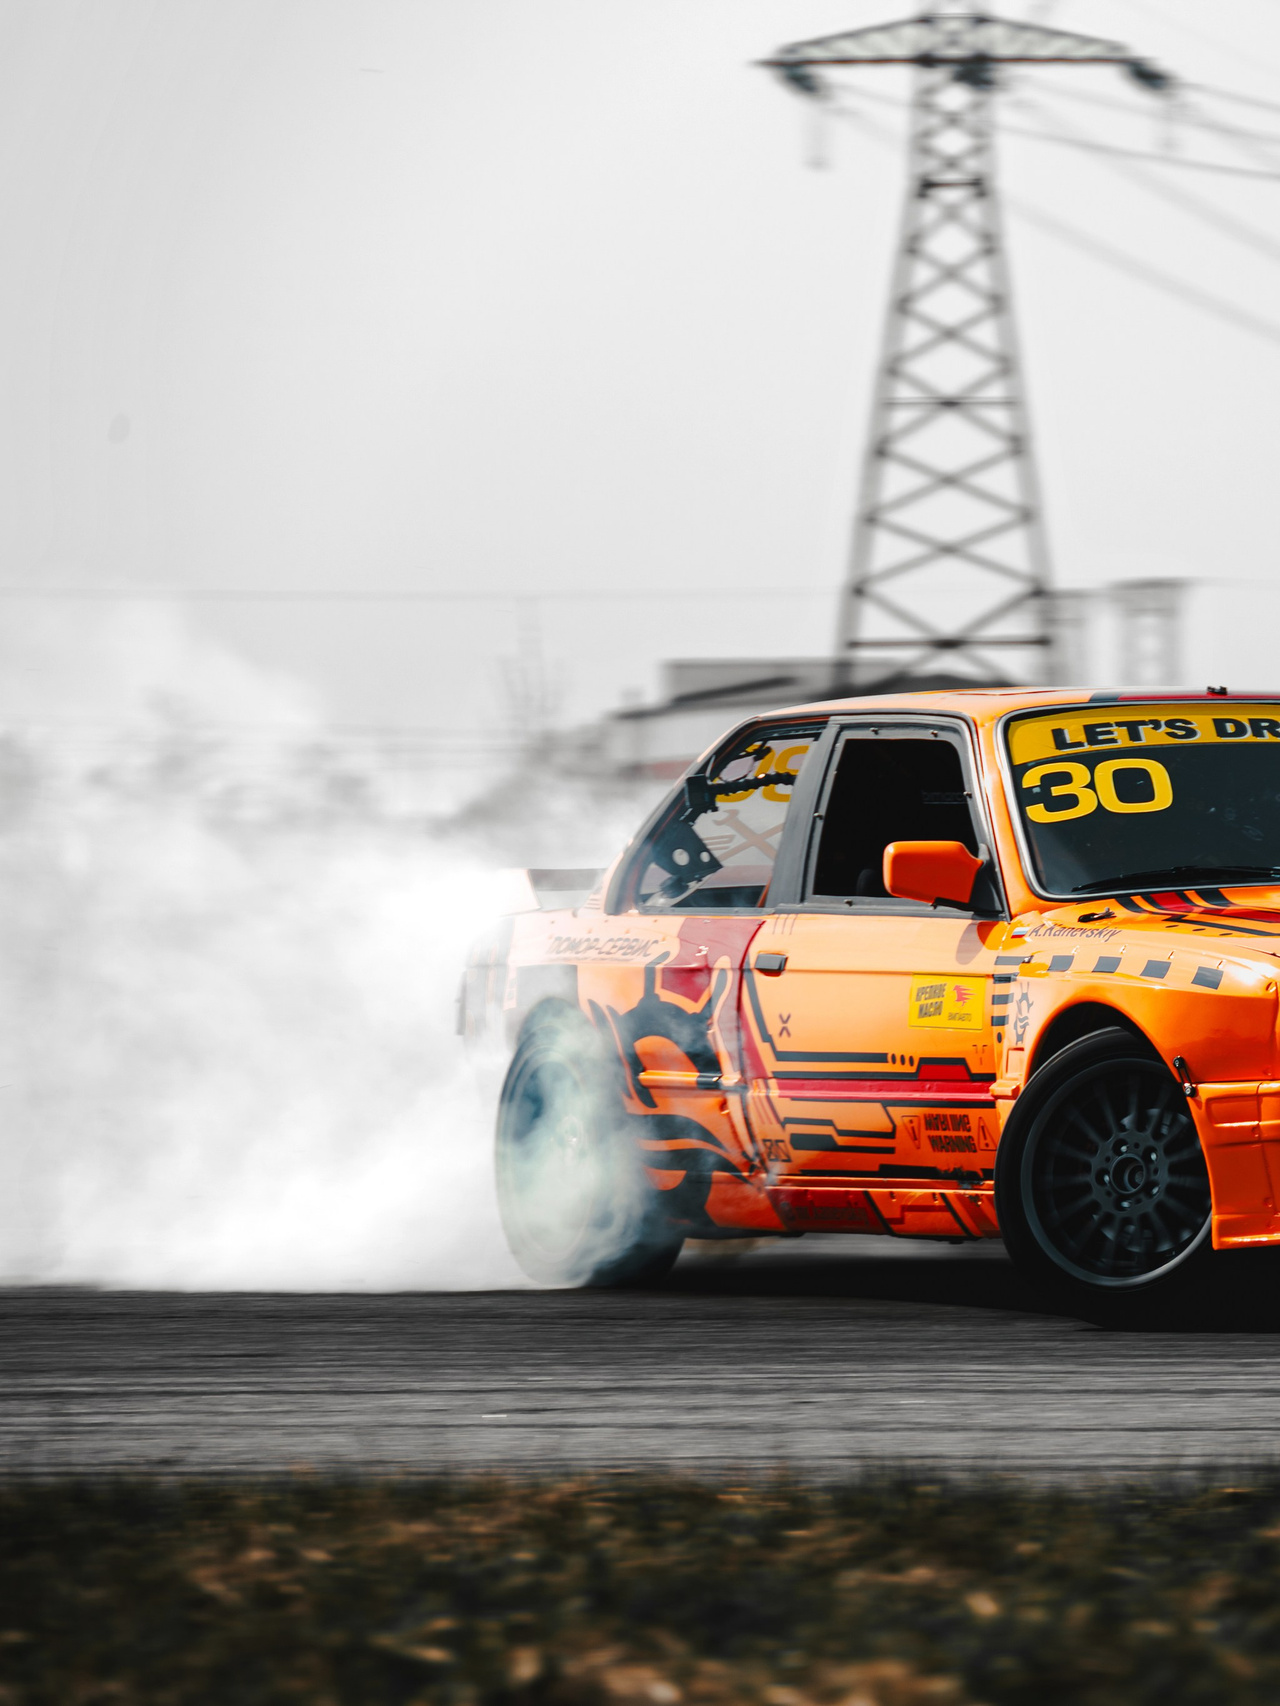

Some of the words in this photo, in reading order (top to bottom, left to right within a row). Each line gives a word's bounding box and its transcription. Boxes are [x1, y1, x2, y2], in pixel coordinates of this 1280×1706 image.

[1051, 717, 1201, 751] LET'S
[1020, 757, 1174, 825] 30
[927, 1135, 978, 1153] WARNING
